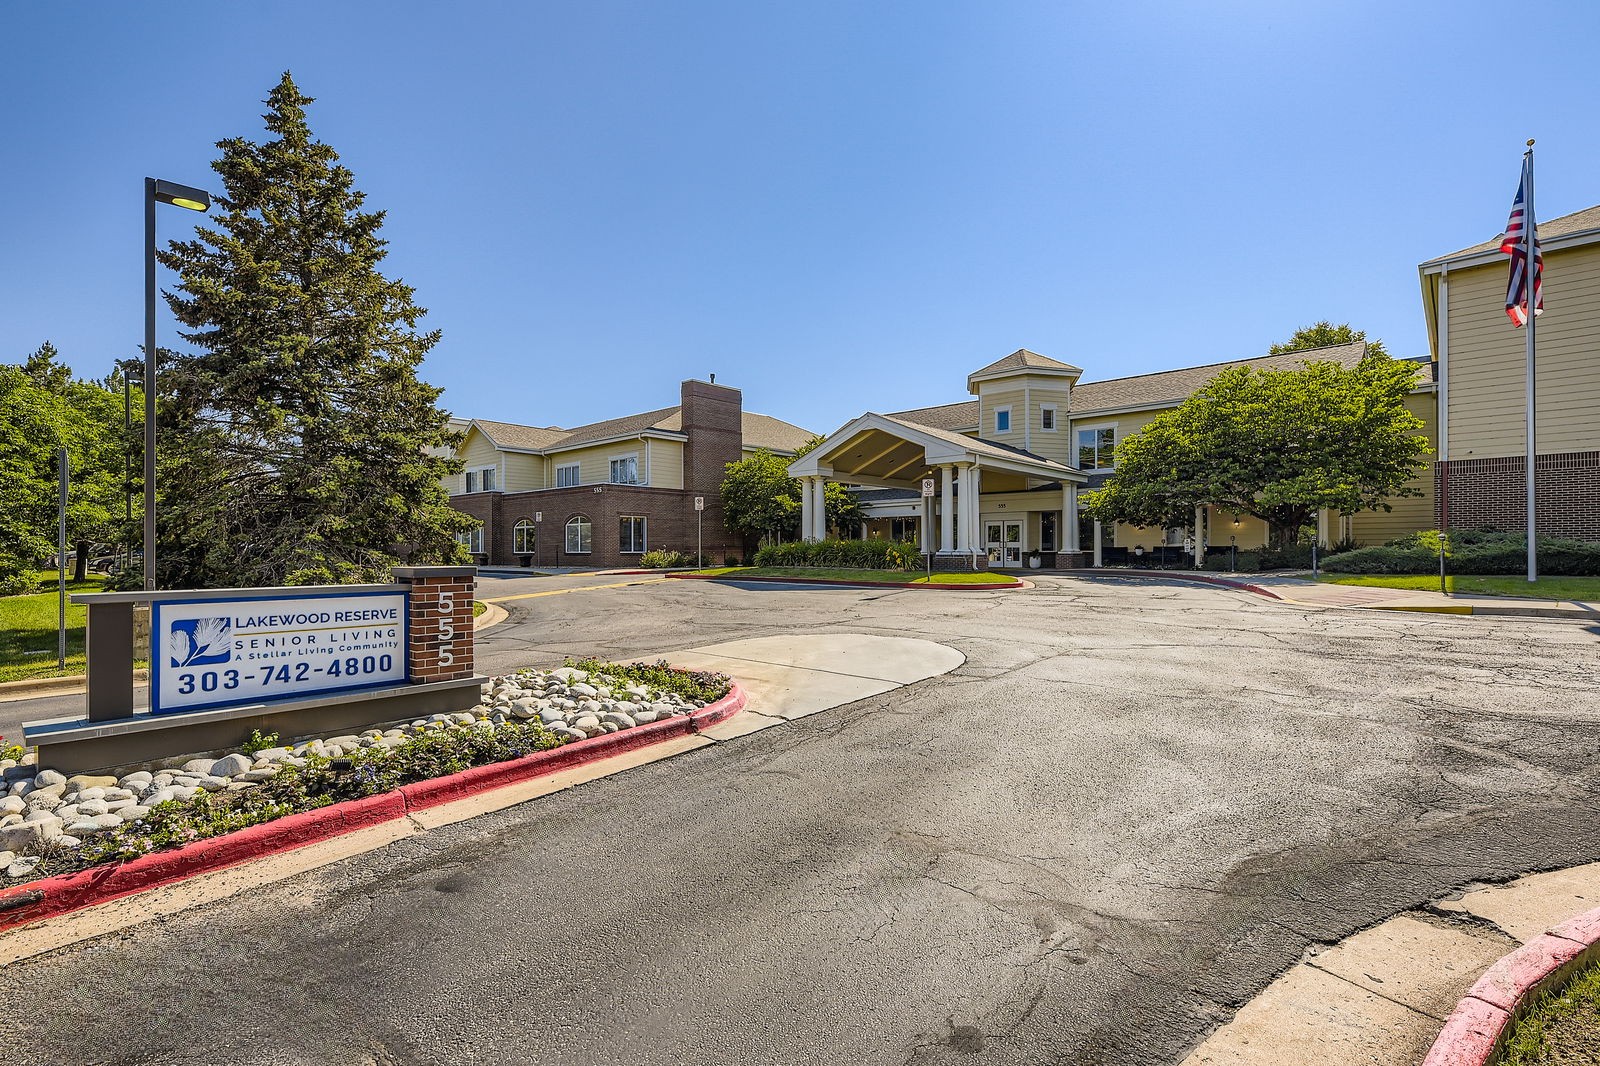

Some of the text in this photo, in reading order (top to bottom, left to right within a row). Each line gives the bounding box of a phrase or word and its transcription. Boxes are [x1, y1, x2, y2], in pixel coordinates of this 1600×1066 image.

[235, 608, 397, 629] LAKEWOOD RESERVE
[235, 629, 396, 650] SENIOR LIVING
[248, 650, 292, 660] Stellar
[298, 646, 334, 656] Living
[338, 641, 399, 652] Community
[178, 654, 392, 695] 303-742-4800
